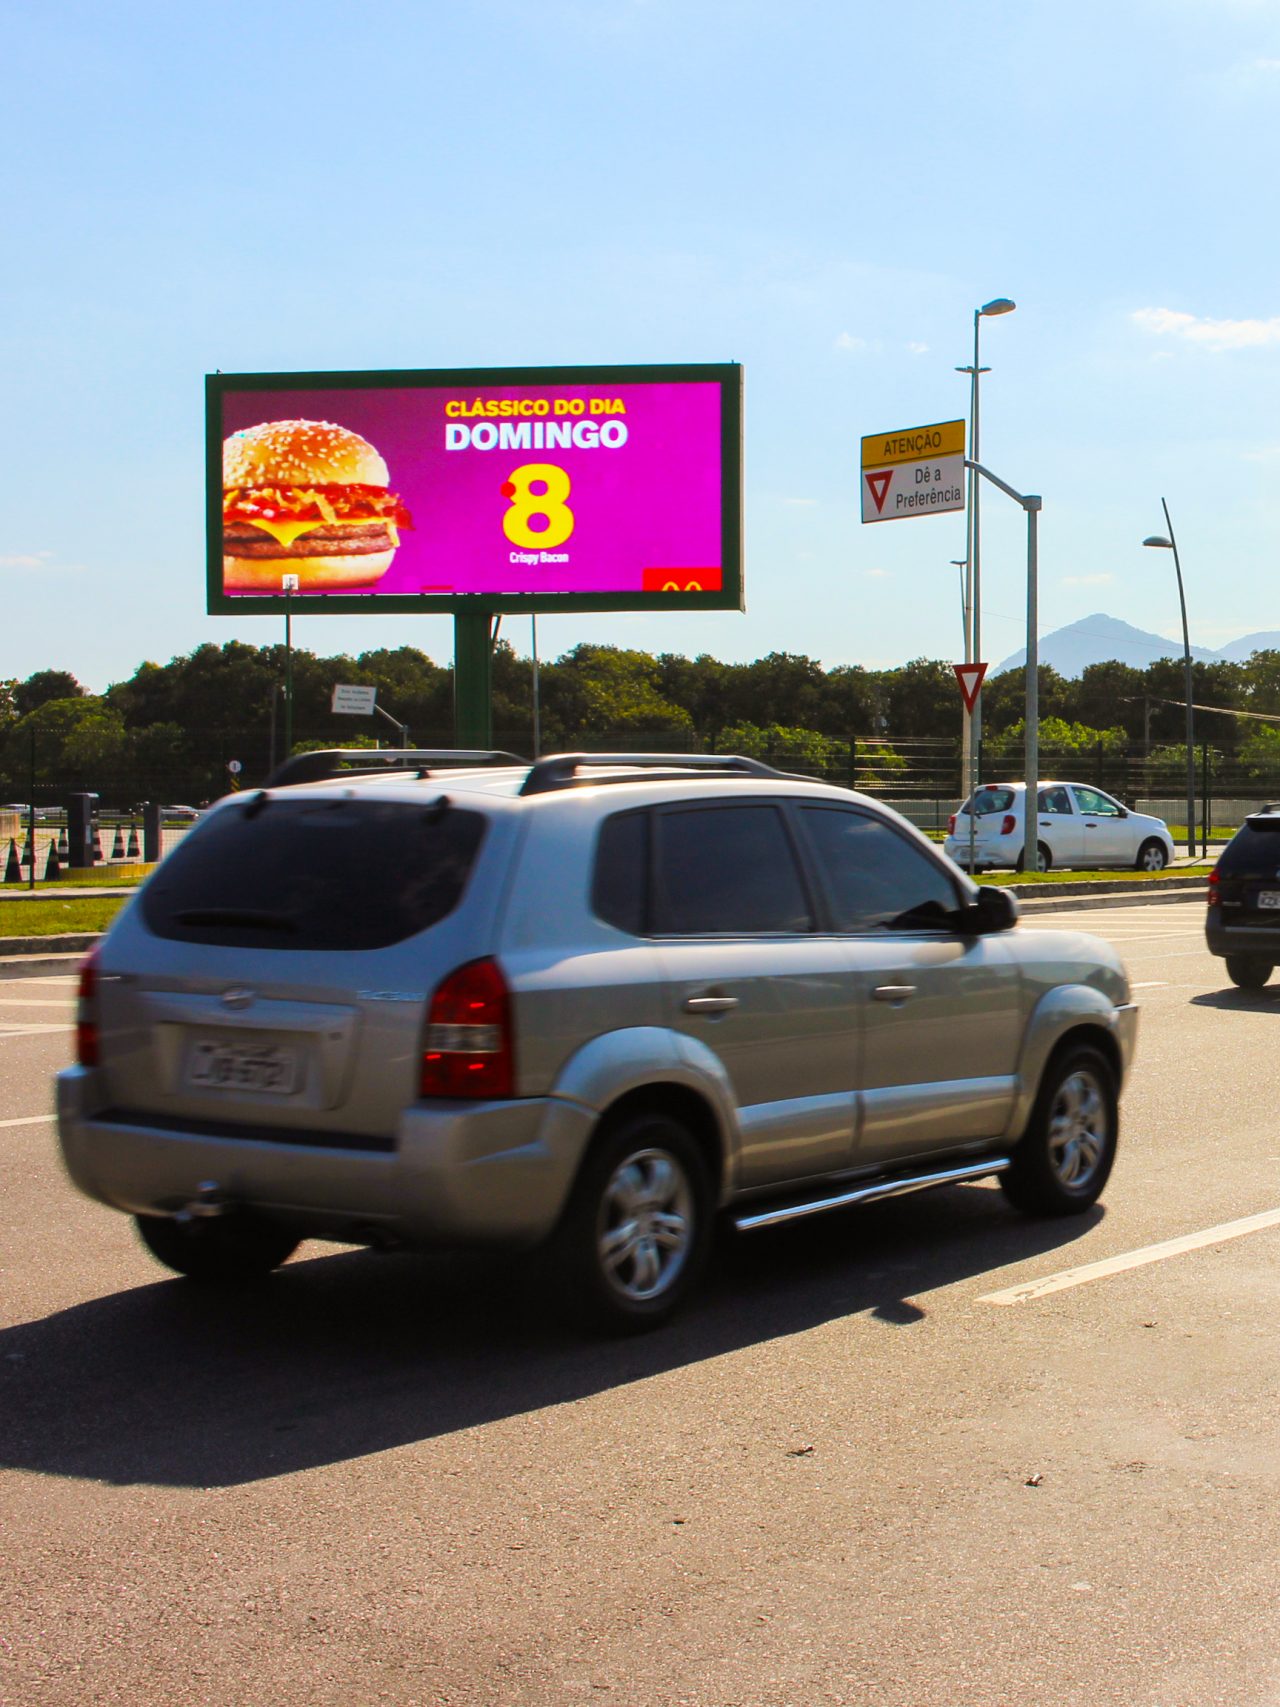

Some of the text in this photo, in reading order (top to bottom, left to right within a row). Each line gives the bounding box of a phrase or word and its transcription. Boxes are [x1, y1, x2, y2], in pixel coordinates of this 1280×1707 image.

[445, 397, 626, 417] CLÁSSICO DO DIA
[445, 420, 628, 451] DOMINGO
[884, 430, 942, 456] ATENÇÃO
[915, 466, 942, 484] Dê a
[502, 463, 575, 549] 8
[896, 486, 961, 509] Preferência
[509, 551, 569, 565] Crispy Bacon
